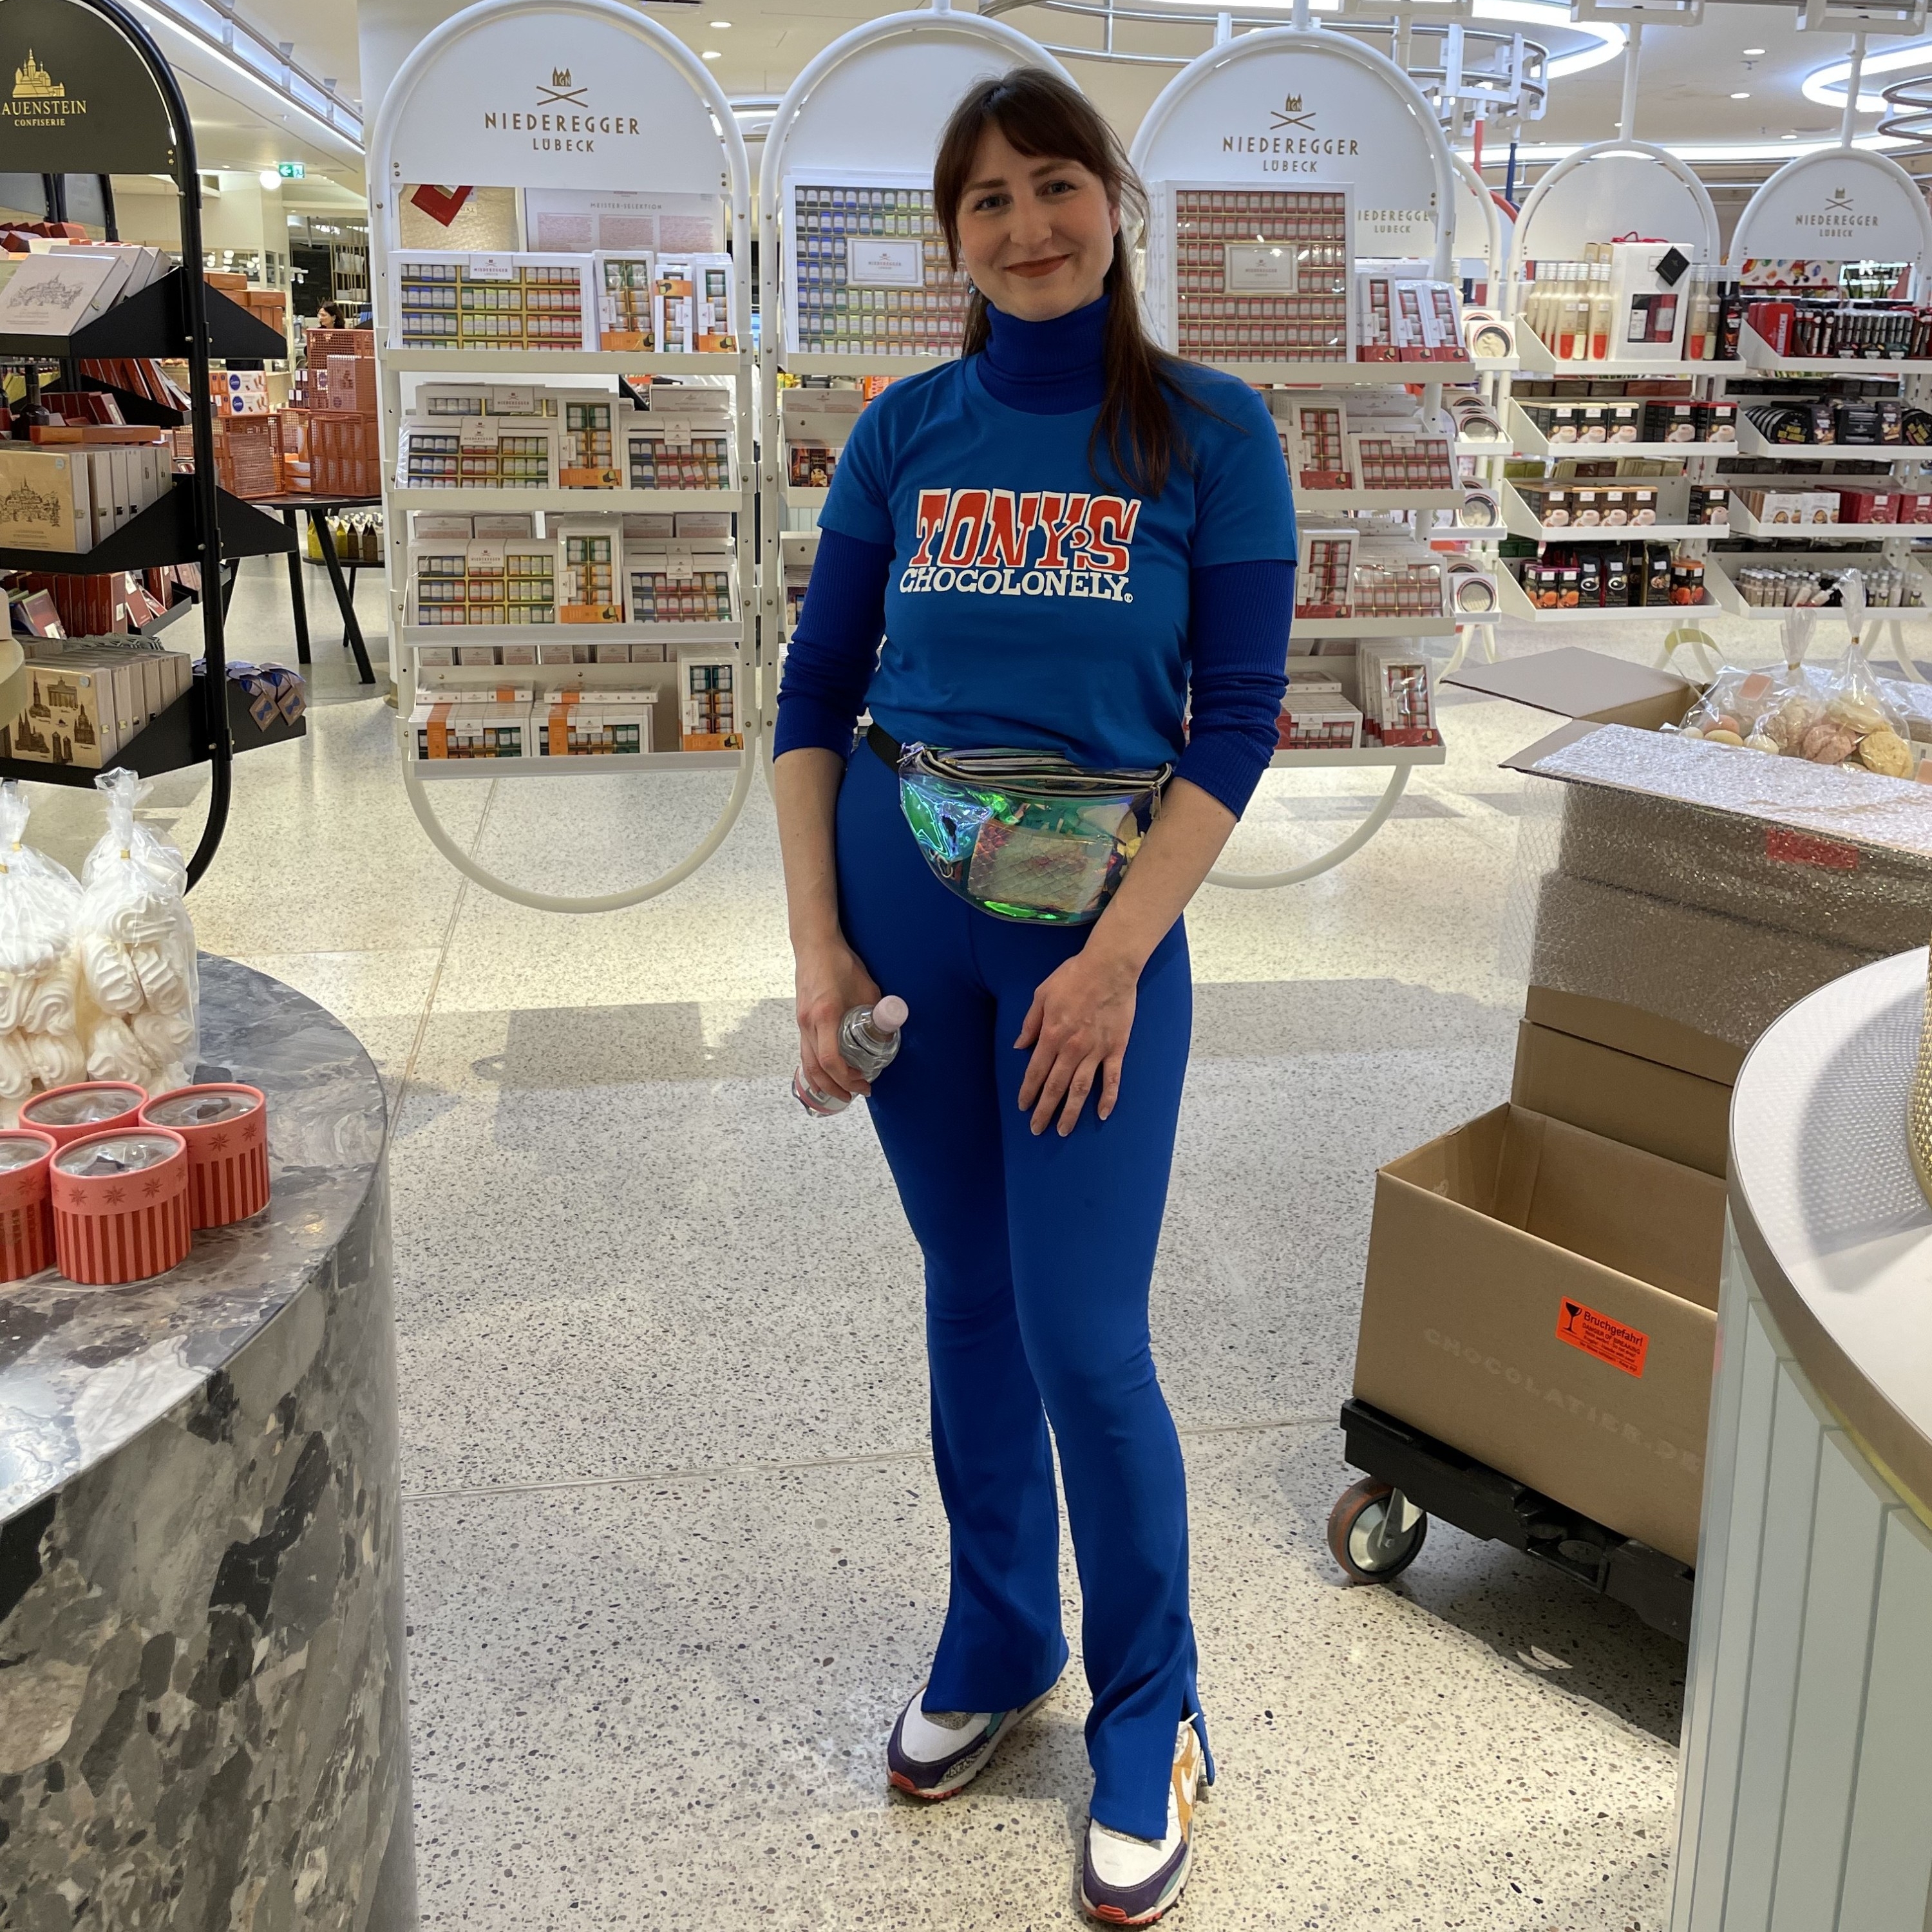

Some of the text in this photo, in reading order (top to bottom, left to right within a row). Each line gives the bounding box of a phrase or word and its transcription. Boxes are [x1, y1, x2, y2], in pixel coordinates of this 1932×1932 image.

[0, 100, 86, 115] AUENSTEIN
[14, 118, 66, 127] CONFISERIE
[485, 112, 639, 135] NIEDEREGGER
[1223, 137, 1358, 155] NIEDEREGGER
[1358, 210, 1429, 221] IEDEREGGE
[1795, 214, 1879, 226] NIEDEREGGER
[909, 488, 1141, 575] TONY'S
[1584, 1311, 1643, 1347] Bruchgefahr!
[1582, 1322, 1604, 1337] DANGER
[1613, 1337, 1641, 1355] BREAKING
